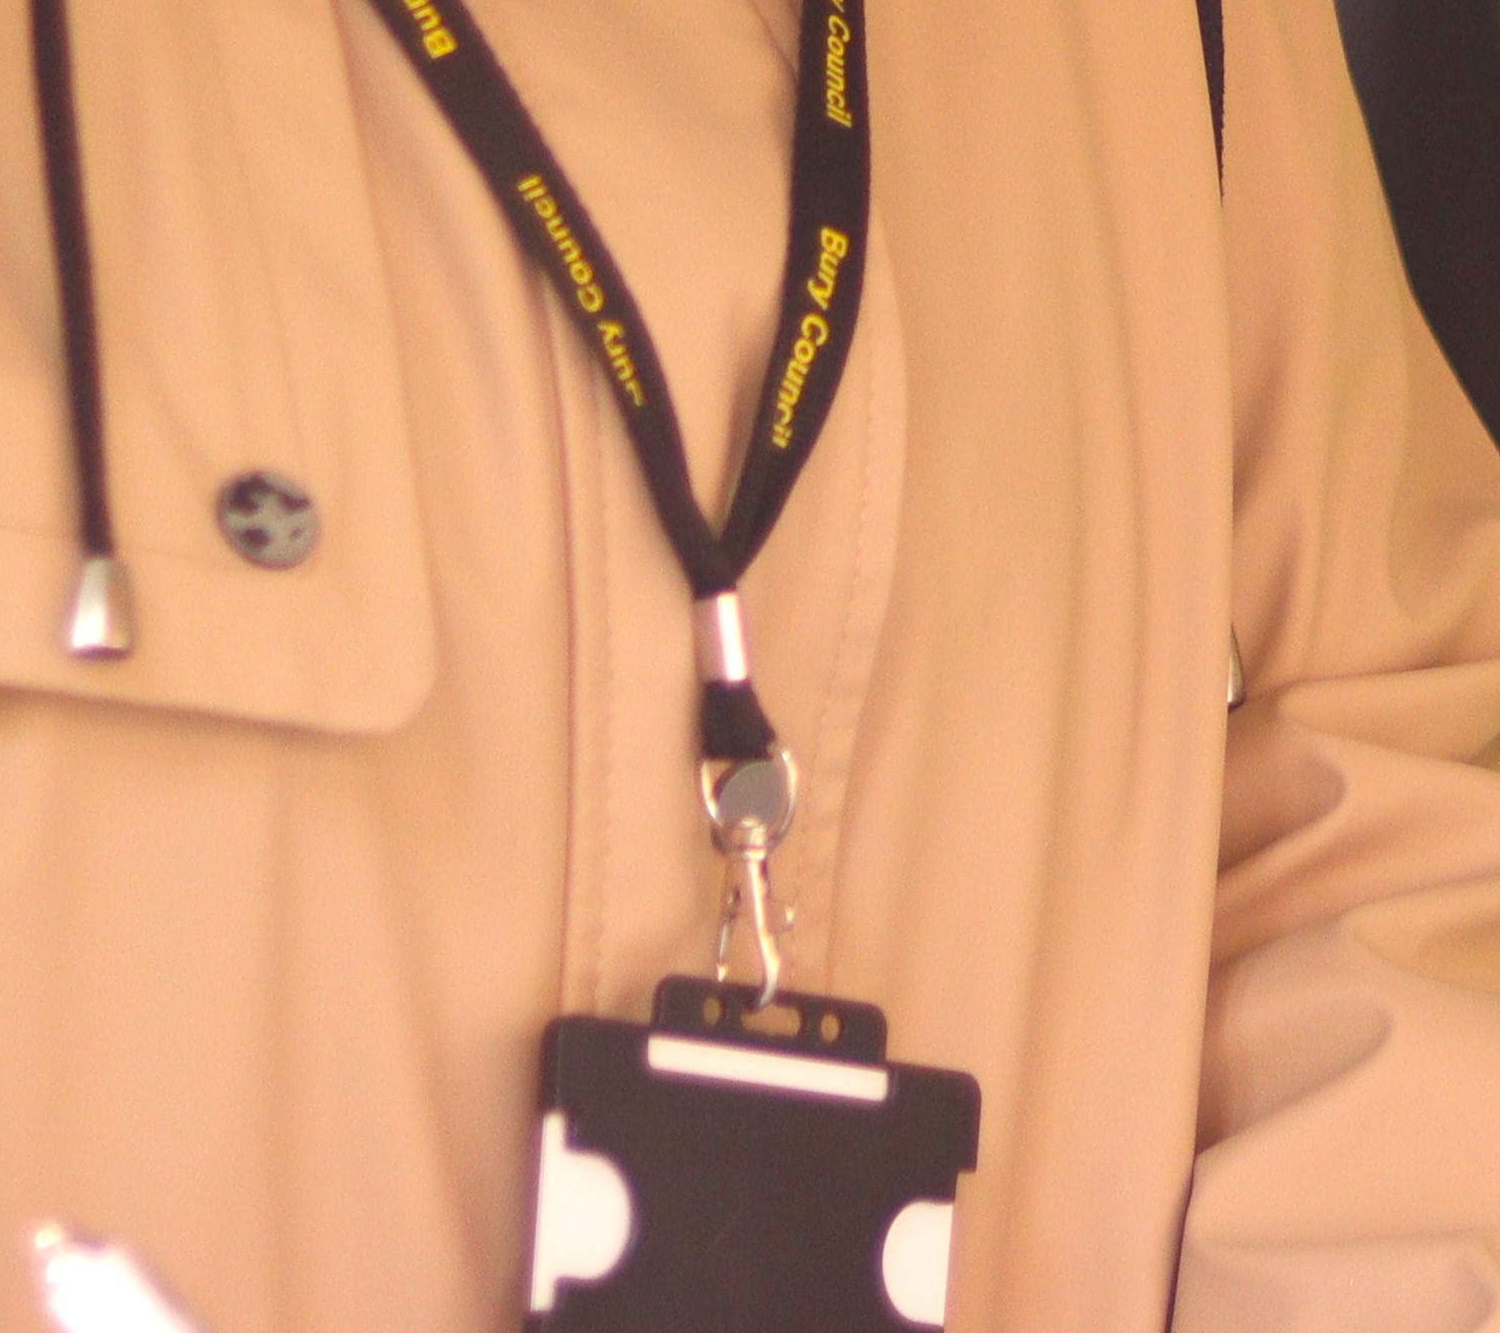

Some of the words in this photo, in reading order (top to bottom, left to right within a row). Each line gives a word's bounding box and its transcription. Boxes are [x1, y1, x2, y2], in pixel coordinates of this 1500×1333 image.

[825, 13, 853, 128] Council
[517, 175, 605, 314] Council
[806, 226, 850, 310] Bury
